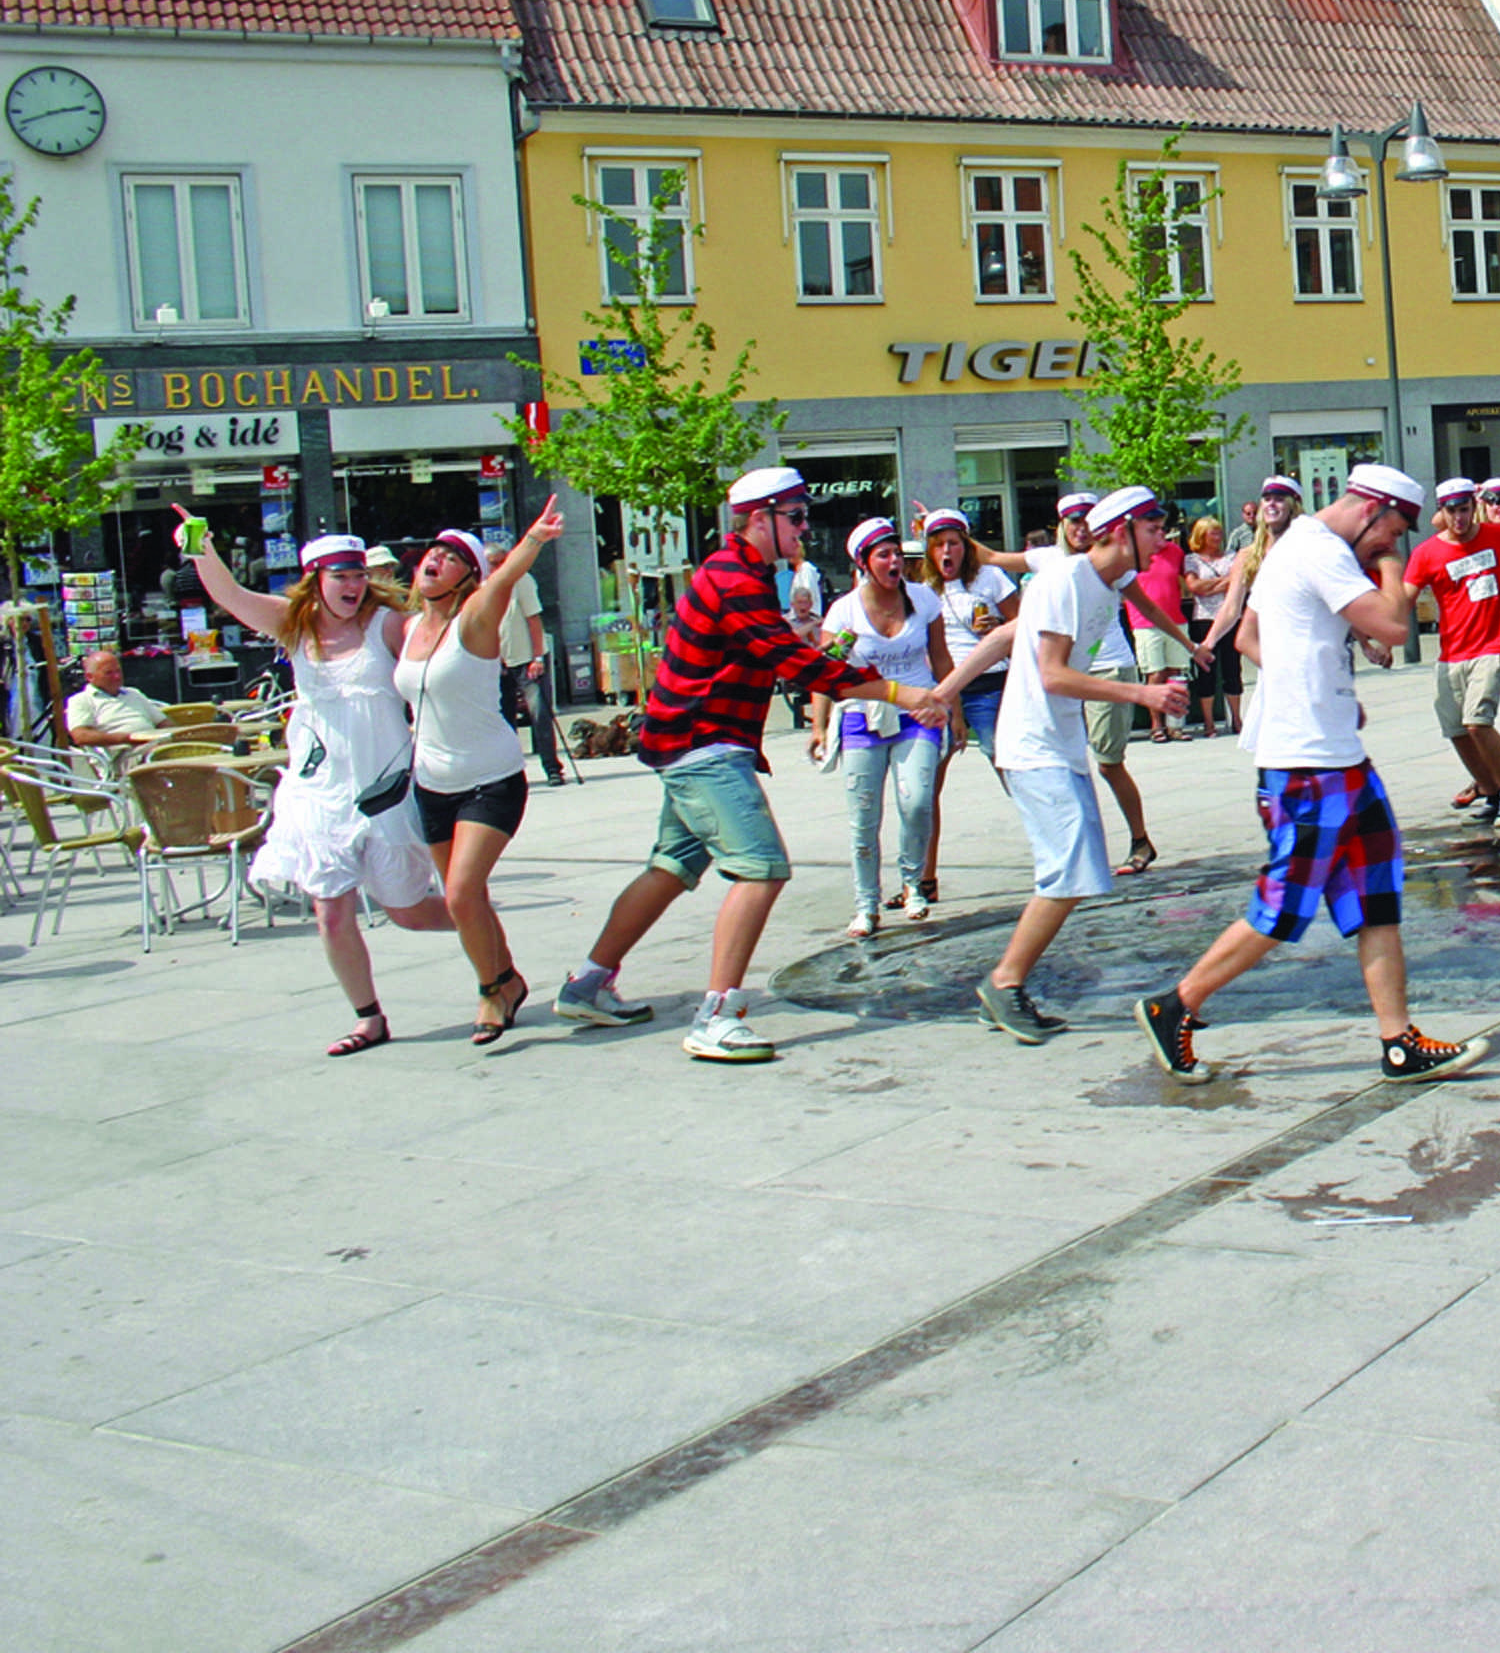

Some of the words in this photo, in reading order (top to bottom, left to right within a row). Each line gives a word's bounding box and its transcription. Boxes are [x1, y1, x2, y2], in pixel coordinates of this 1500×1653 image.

[888, 339, 1128, 383] TIGER
[195, 426, 217, 448] &
[229, 417, 280, 446] idé
[807, 480, 873, 494] TIGER
